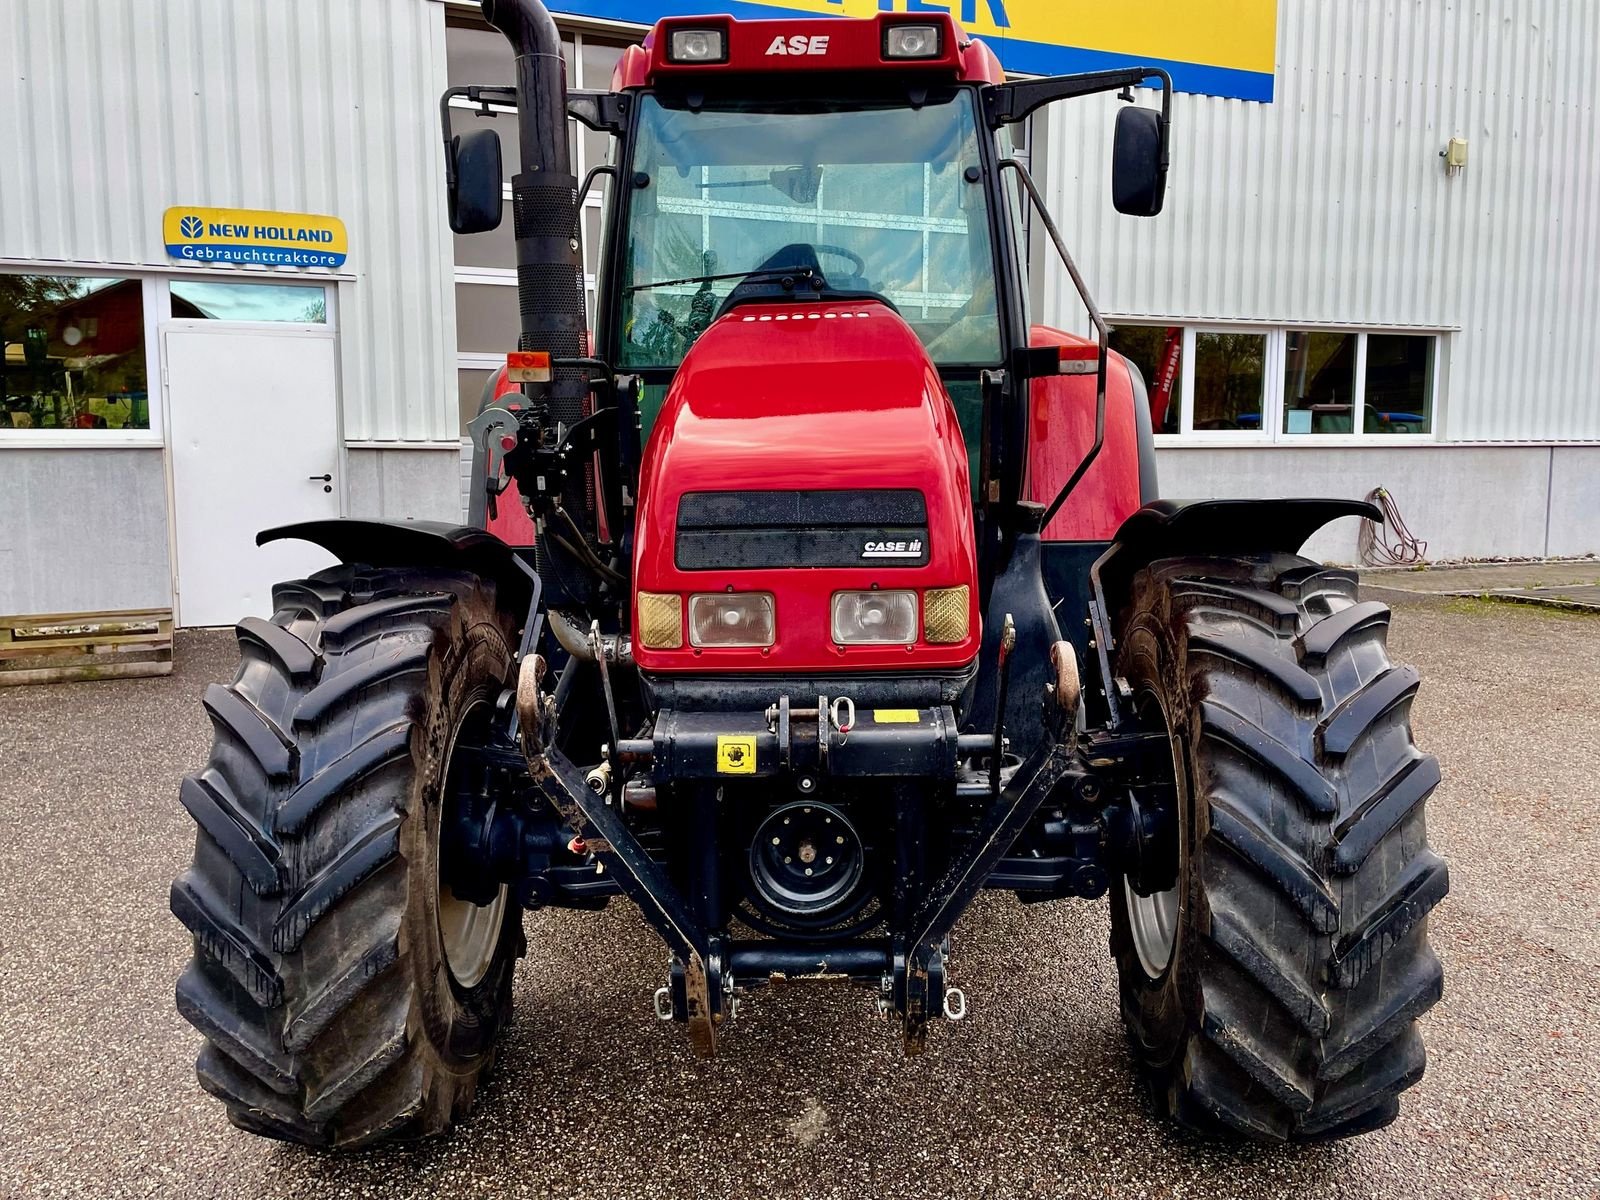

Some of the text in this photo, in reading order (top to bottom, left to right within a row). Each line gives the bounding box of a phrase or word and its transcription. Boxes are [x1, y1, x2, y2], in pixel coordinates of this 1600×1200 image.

[765, 35, 830, 55] ASE
[209, 223, 333, 243] NEW HOLLAND
[182, 245, 336, 265] Gebrauchttraktore
[864, 541, 906, 552] CASE
